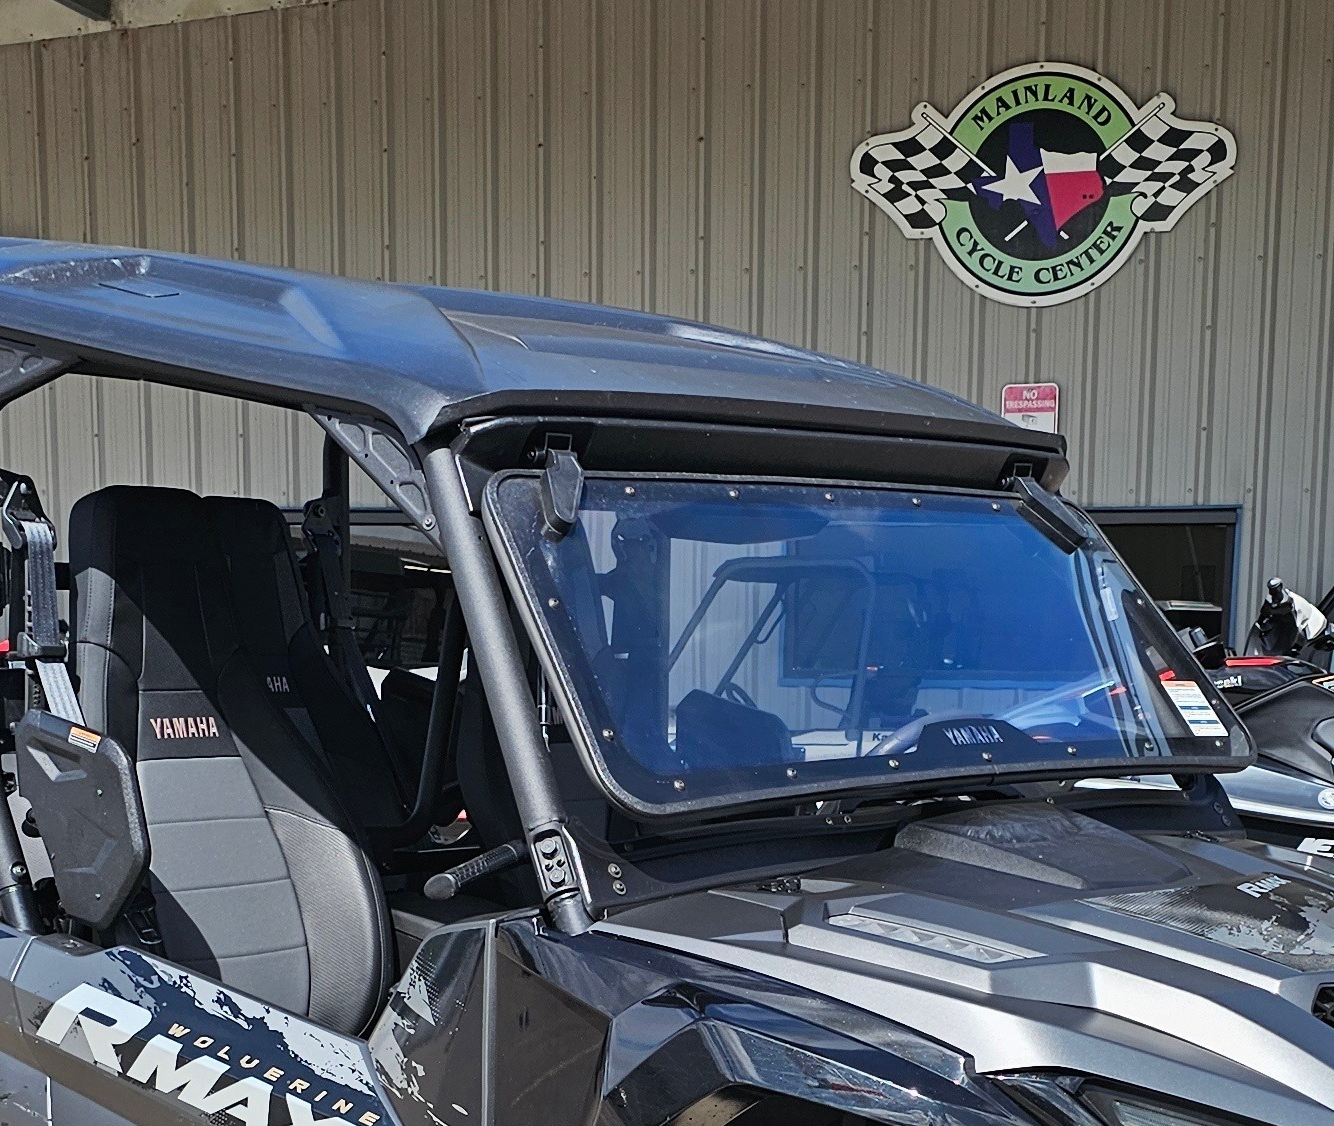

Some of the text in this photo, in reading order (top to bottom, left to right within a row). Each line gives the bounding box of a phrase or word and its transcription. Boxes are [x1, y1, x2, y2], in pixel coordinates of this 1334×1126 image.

[971, 82, 1114, 132] MAINLAND
[955, 221, 1125, 286] CYCLE CENTER
[1005, 400, 1055, 409] TRESPASSING
[1022, 390, 1038, 400] NO
[149, 716, 220, 740] YAMAHA
[942, 725, 1004, 746] YAMAHA
